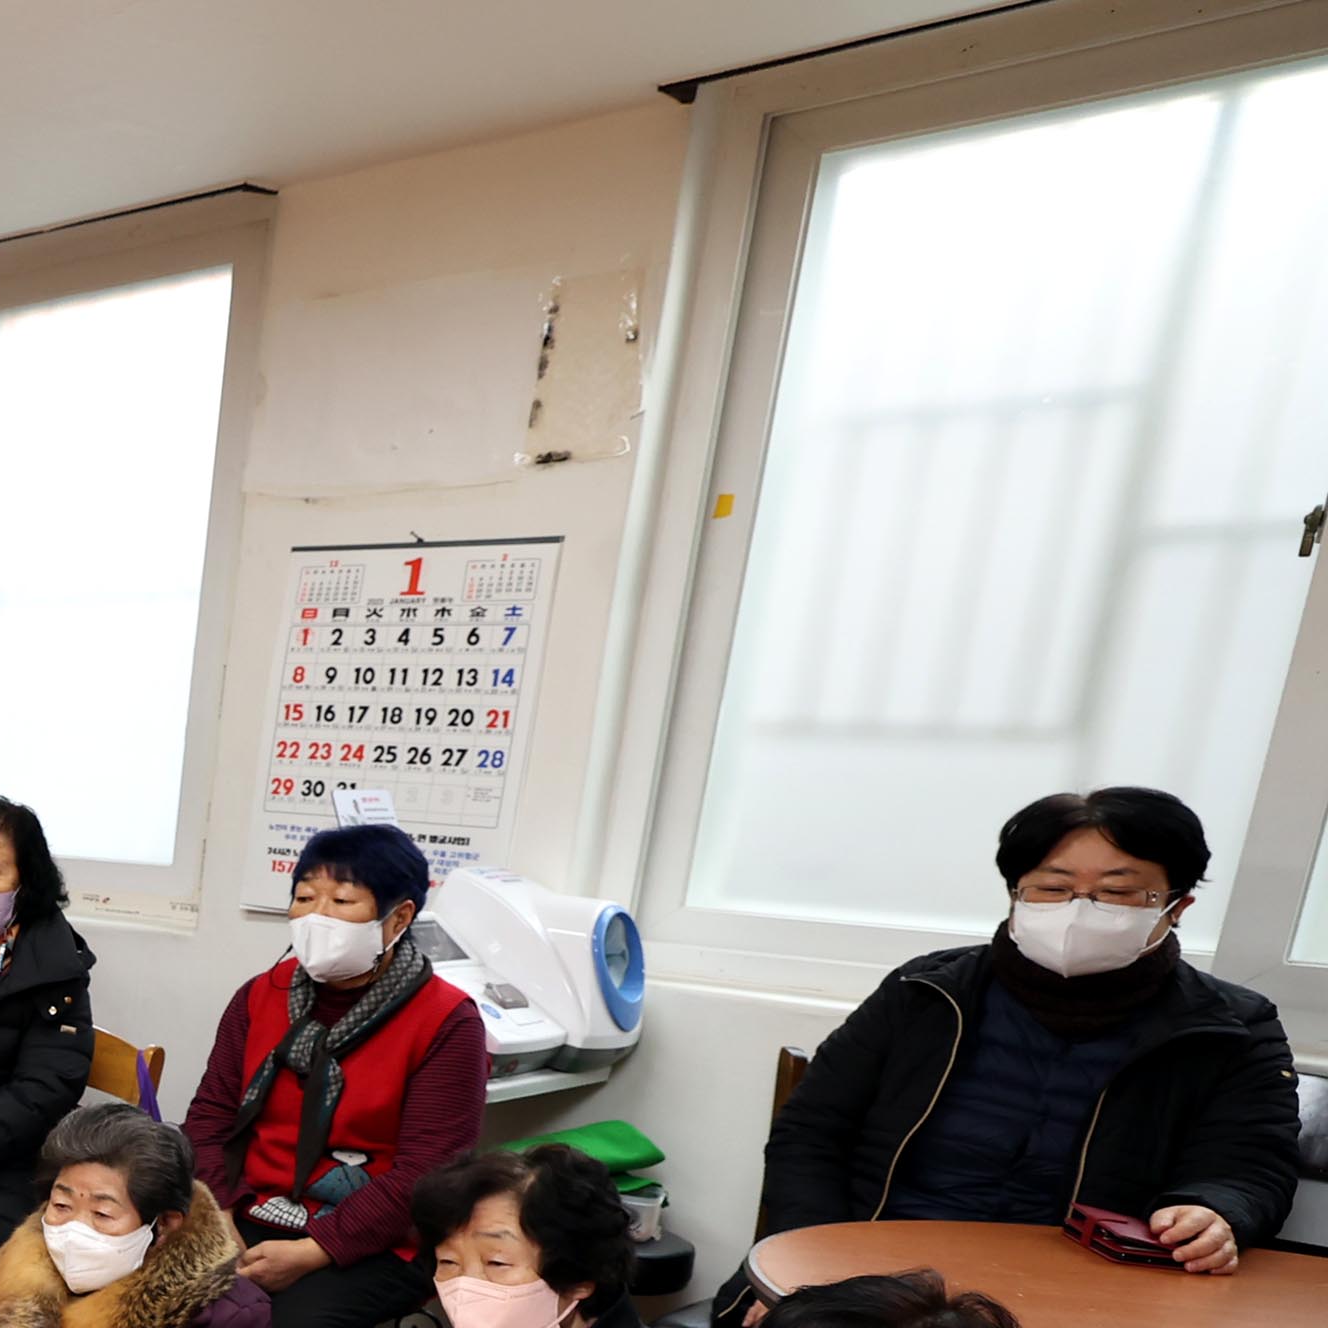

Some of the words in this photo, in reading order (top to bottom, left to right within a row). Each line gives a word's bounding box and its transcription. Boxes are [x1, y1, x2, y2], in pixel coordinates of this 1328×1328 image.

[399, 556, 426, 597] 1
[301, 608, 318, 619] 日
[333, 608, 349, 618] 月
[366, 609, 382, 618] 火
[401, 608, 417, 617] 水
[435, 607, 451, 617] 木
[471, 607, 486, 617] 金
[505, 606, 521, 616] 土
[303, 629, 309, 645] 1
[332, 629, 342, 645] 2
[364, 628, 376, 645] 3
[398, 628, 410, 645] 4
[432, 628, 444, 645] 5
[467, 628, 479, 645] 6
[503, 627, 516, 645] 7
[293, 667, 304, 683] 8
[326, 667, 337, 684] 9
[355, 668, 375, 684] 10
[390, 668, 408, 685] 11
[423, 668, 443, 686] 12
[458, 669, 478, 686] 13
[493, 669, 514, 687] 14
[285, 704, 303, 720] 15
[317, 705, 335, 722] 16
[349, 706, 369, 723] 17
[382, 707, 402, 724] 18
[416, 708, 437, 725] 19
[448, 709, 474, 726] 20
[487, 710, 509, 728] 21
[277, 741, 299, 758] 22
[309, 743, 331, 760] 23
[341, 744, 364, 761] 24
[374, 746, 396, 763] 25
[407, 747, 431, 765] 26
[442, 749, 467, 766] 27
[478, 750, 504, 768] 28
[272, 778, 293, 795] 29
[302, 780, 324, 797] 30
